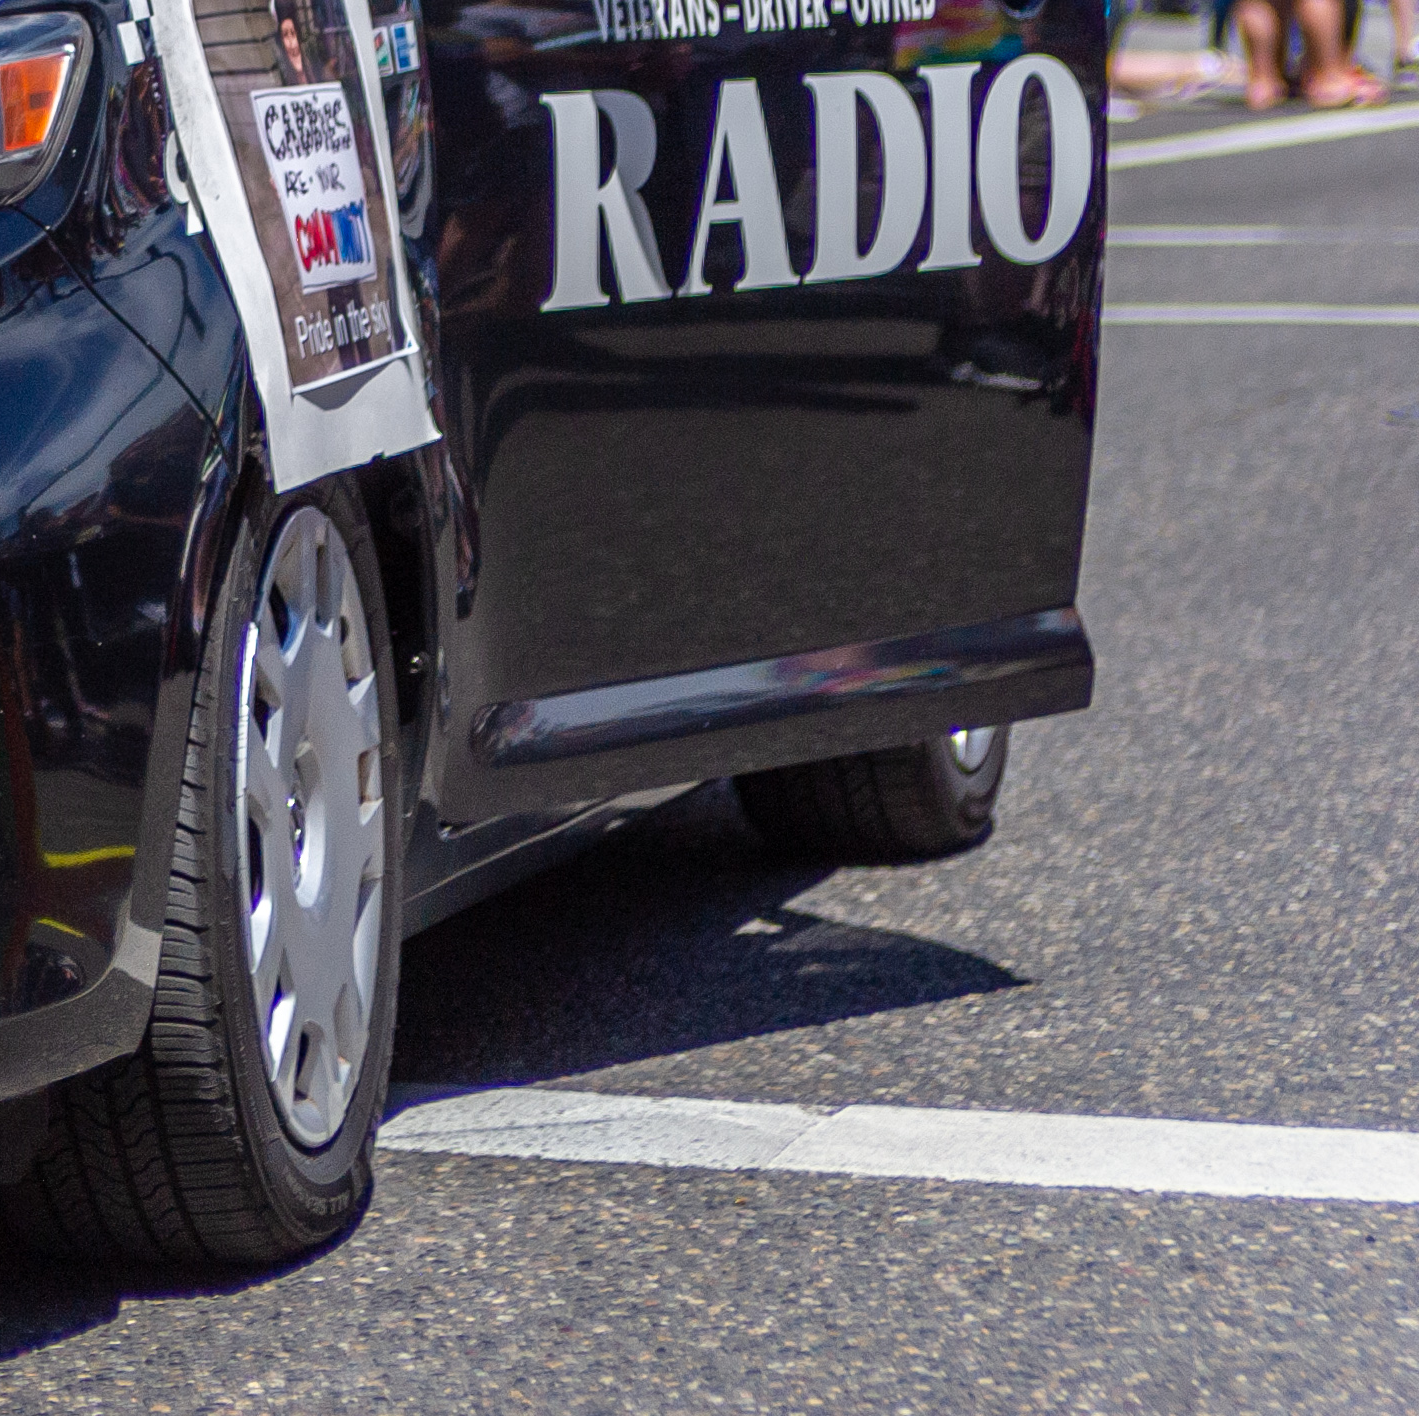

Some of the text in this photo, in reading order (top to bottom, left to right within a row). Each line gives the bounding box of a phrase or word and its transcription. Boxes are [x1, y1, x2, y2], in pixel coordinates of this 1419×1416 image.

[540, 53, 1093, 312] RADIO
[294, 292, 393, 359] Pride in the sky
